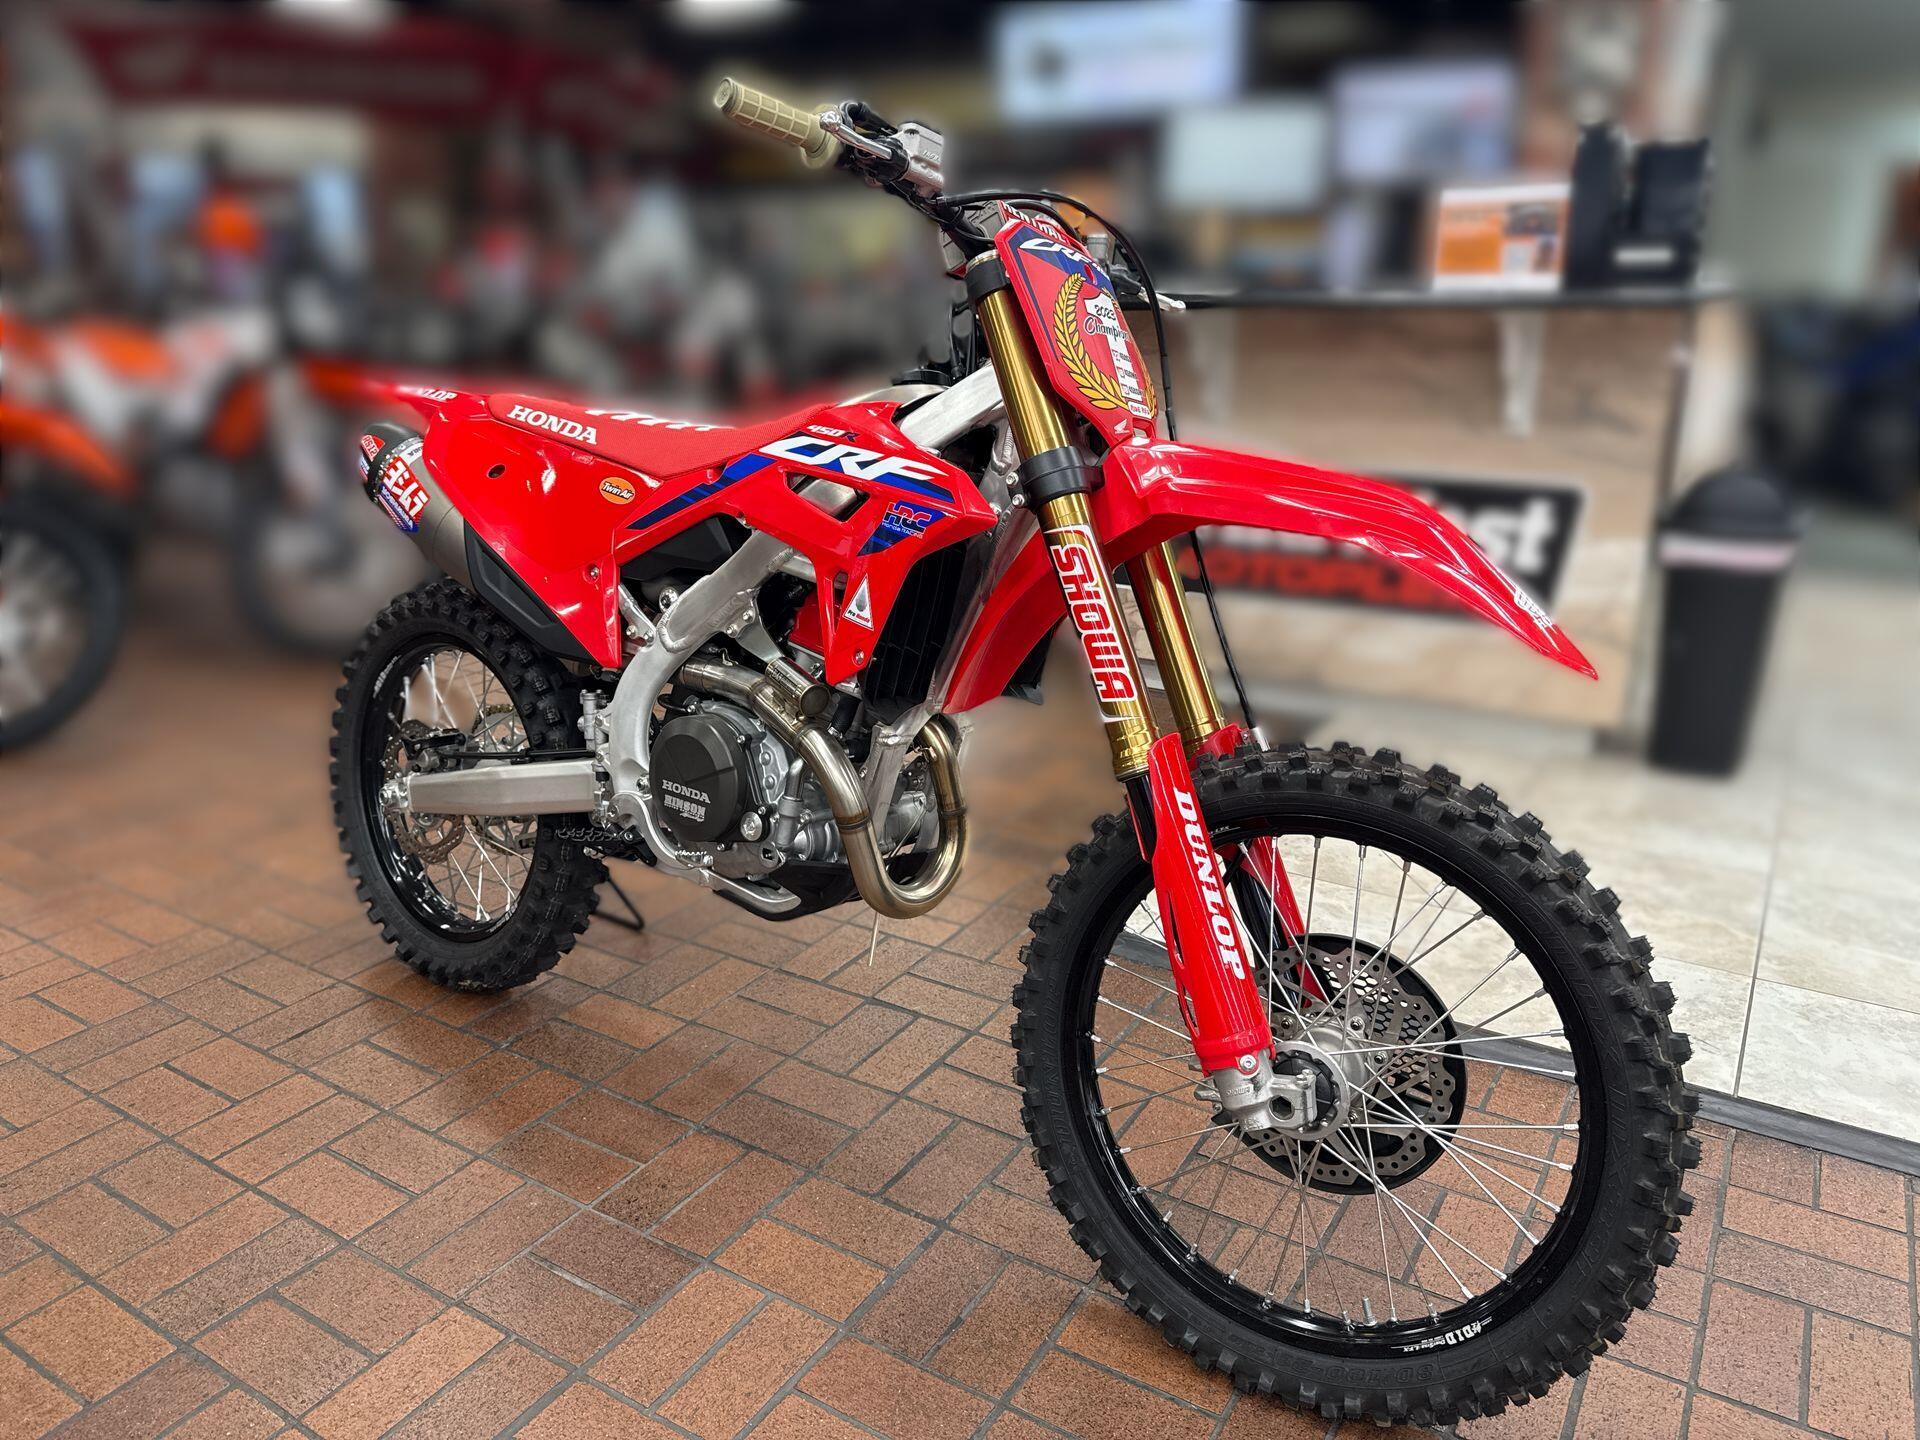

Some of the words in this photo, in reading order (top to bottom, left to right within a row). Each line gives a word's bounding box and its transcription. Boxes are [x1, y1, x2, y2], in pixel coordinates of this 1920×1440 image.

[1019, 237, 1092, 263] CRF
[1094, 303, 1117, 322] 2023
[507, 404, 598, 446] HONDA
[806, 424, 860, 443] 450R
[759, 435, 950, 482] CRF
[602, 481, 622, 496] Twin
[619, 488, 634, 500] Air
[882, 501, 933, 535] HRC
[1050, 544, 1138, 703] SHOWA
[661, 779, 711, 804] HONDA
[1173, 787, 1246, 980] DUNLOP
